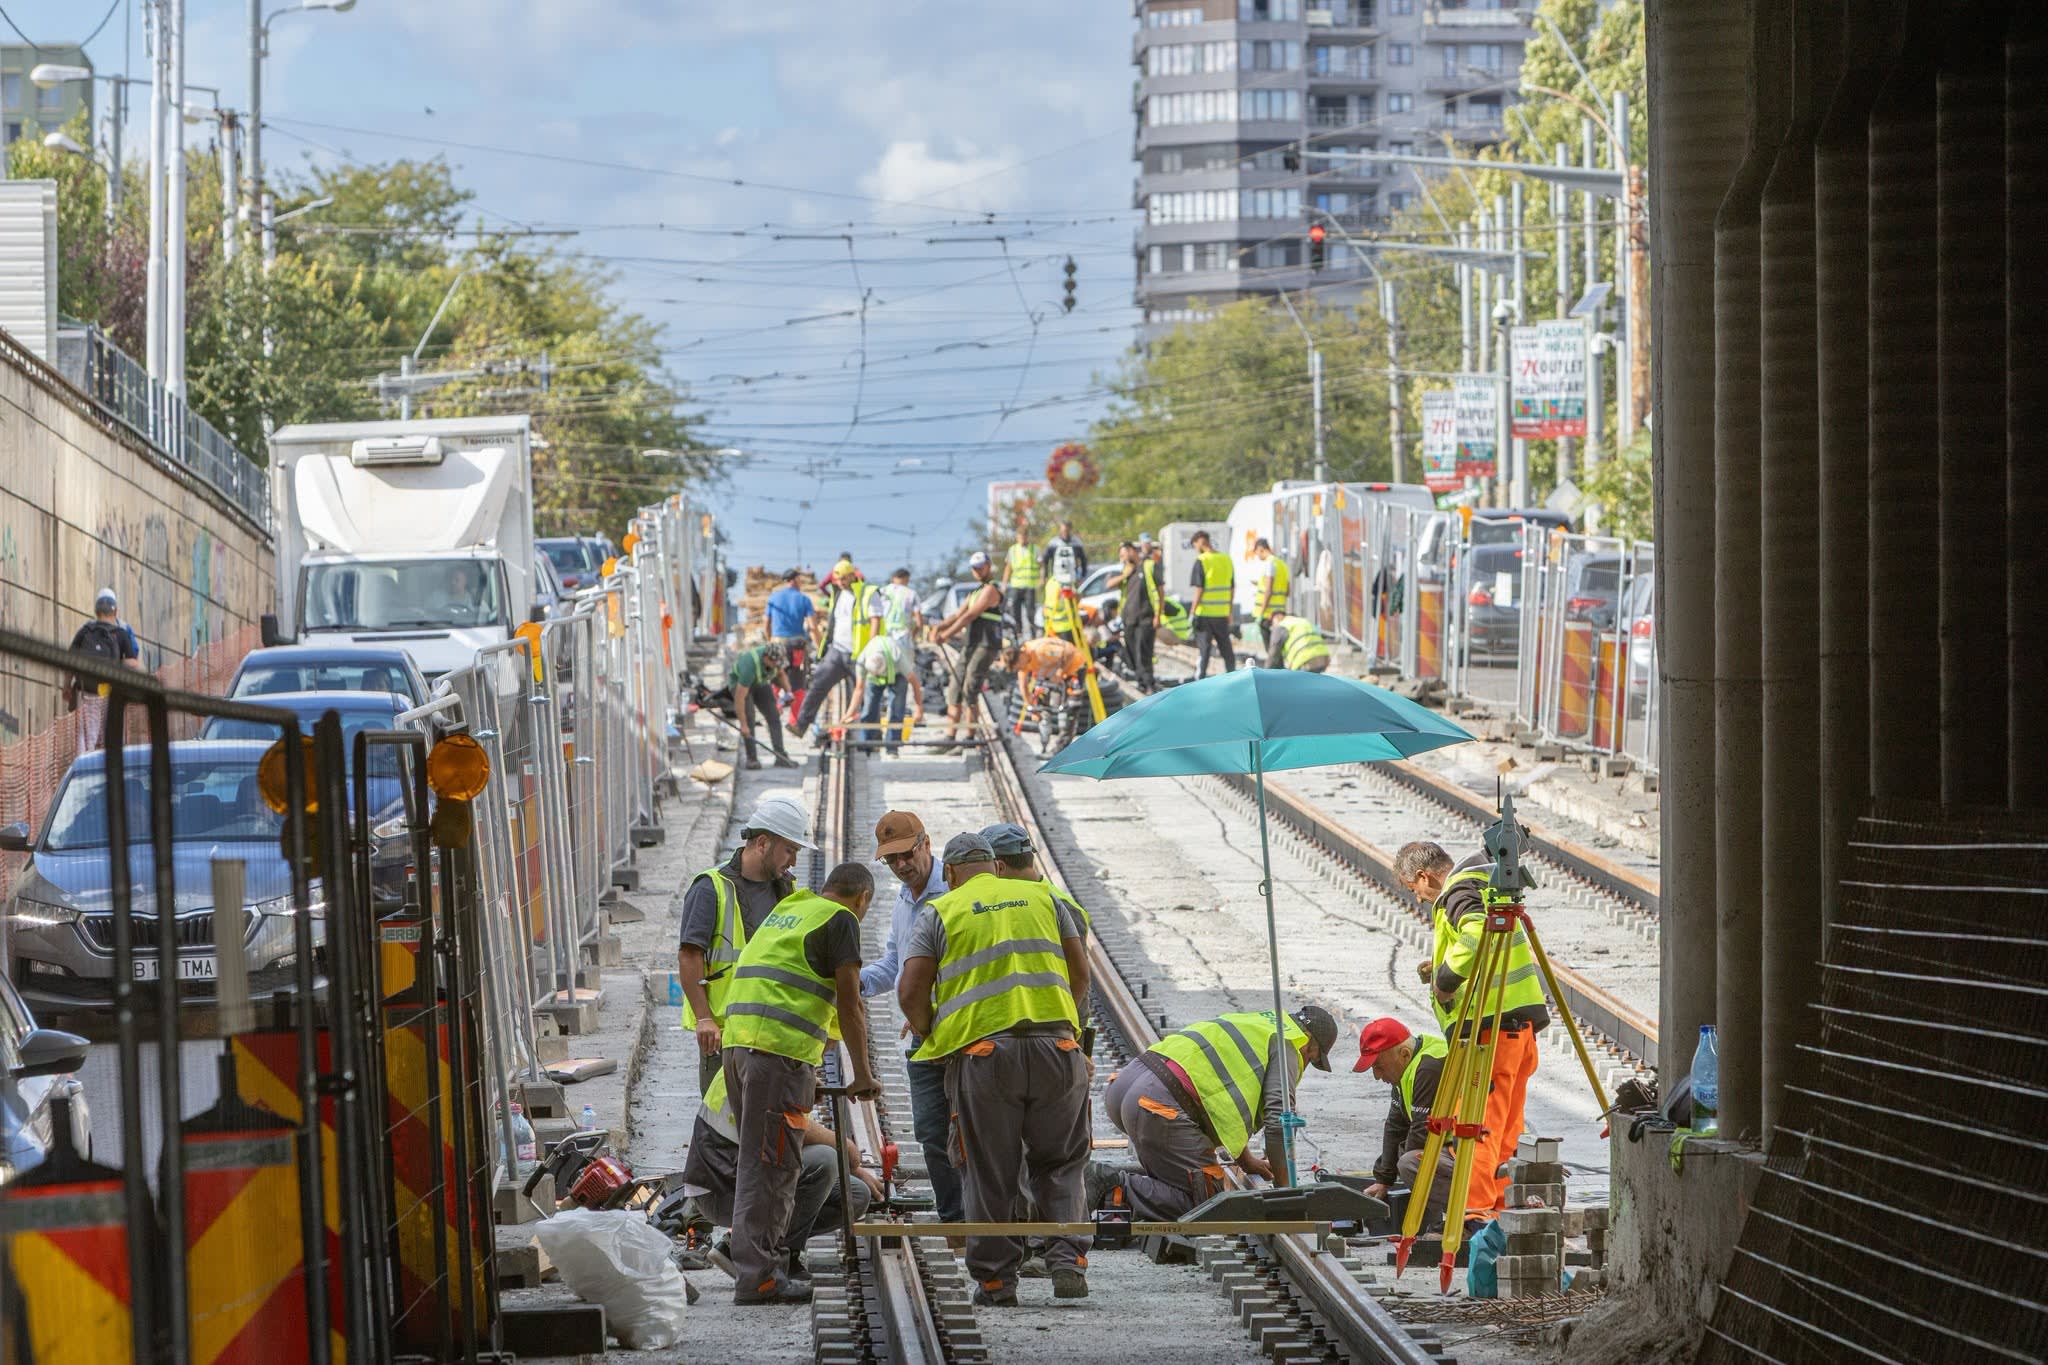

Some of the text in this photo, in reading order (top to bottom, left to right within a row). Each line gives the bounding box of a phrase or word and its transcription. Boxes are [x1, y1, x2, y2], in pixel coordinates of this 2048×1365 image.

[1540, 360, 1584, 374] OUTLET
[133, 962, 146, 978] B
[182, 960, 213, 978] TMA
